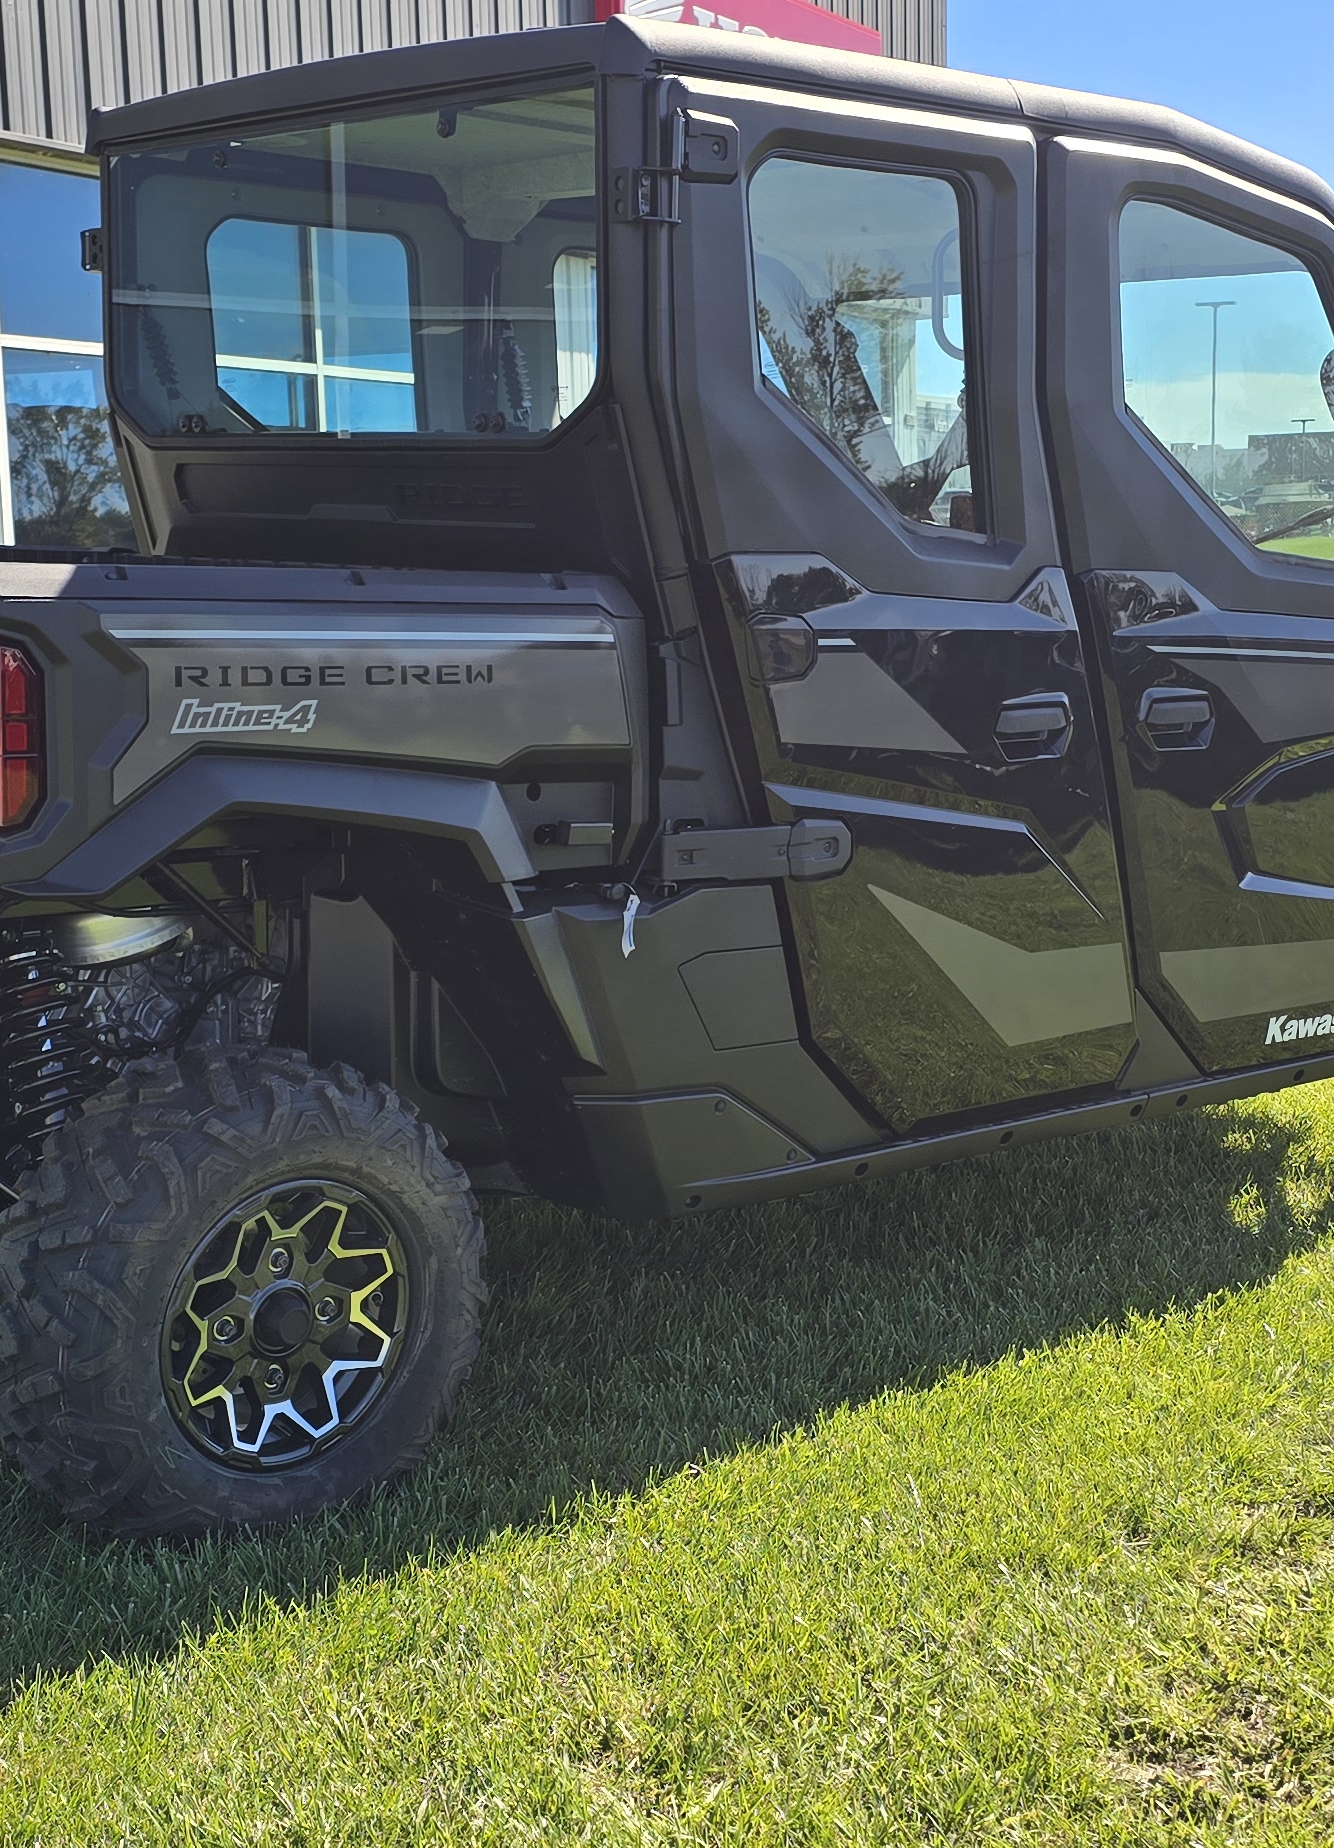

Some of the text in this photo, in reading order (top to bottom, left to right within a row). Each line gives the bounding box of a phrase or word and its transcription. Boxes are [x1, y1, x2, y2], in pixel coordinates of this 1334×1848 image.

[396, 483, 526, 508] RIDGE
[174, 664, 493, 688] RIDGE CREW
[170, 698, 318, 734] Inline-4
